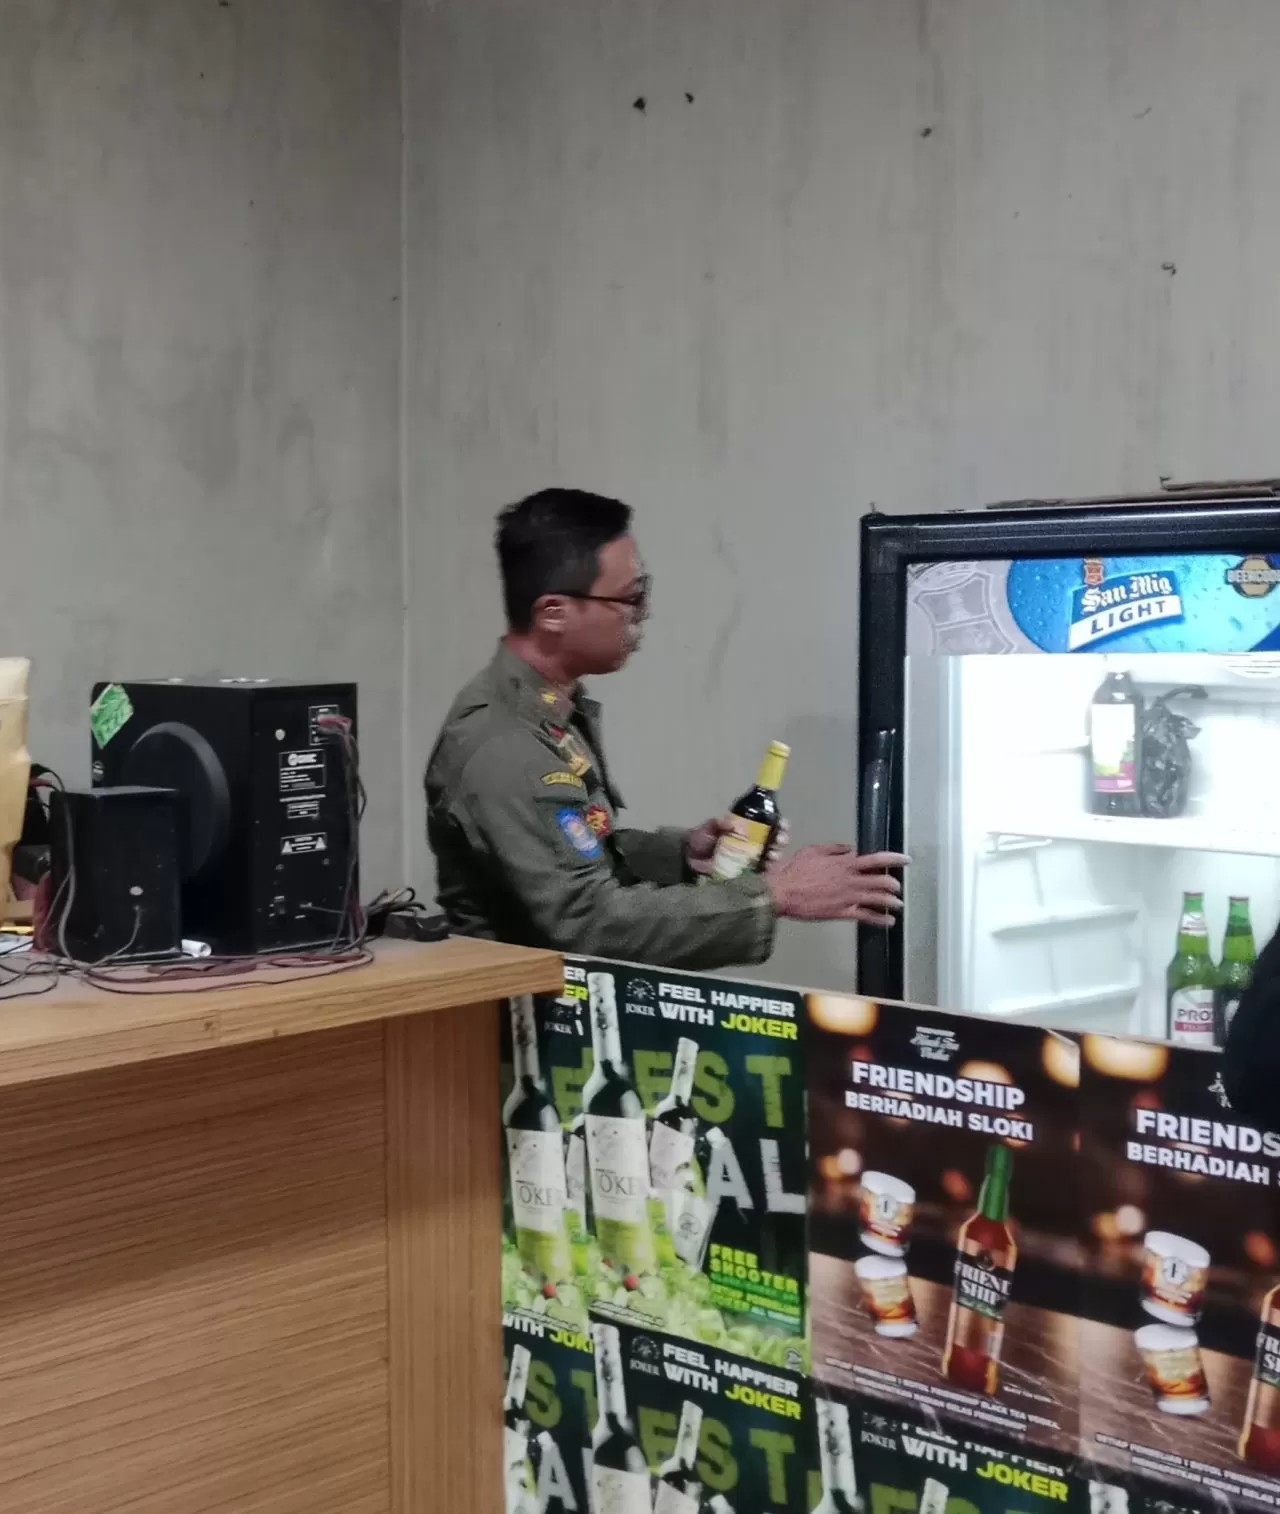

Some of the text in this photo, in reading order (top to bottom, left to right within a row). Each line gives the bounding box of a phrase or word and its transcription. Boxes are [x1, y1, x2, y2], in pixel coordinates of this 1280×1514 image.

[1081, 573, 1173, 614] San Mig
[1091, 600, 1167, 635] LIGHT
[625, 1002, 657, 1018] JOKER
[658, 981, 796, 1019] FEEL HAPPIER
[658, 1001, 799, 1040] WITH JOKER
[1177, 1008, 1216, 1022] PRO
[631, 1047, 793, 1129] EST
[852, 1061, 1026, 1111] FRIENDSHIP
[845, 1091, 1035, 1141] BERHADIAH SLOKI
[705, 1130, 807, 1215] AL
[1127, 1141, 1271, 1185] BERHADIAH
[663, 1342, 710, 1371] FEEL
[715, 1358, 799, 1398] HAPPIER
[663, 1361, 801, 1420] WITH JOKER
[638, 1404, 796, 1505] EST
[861, 1430, 896, 1451] JOKER
[901, 1435, 968, 1472] WITH
[976, 1460, 1069, 1502] JOKER
